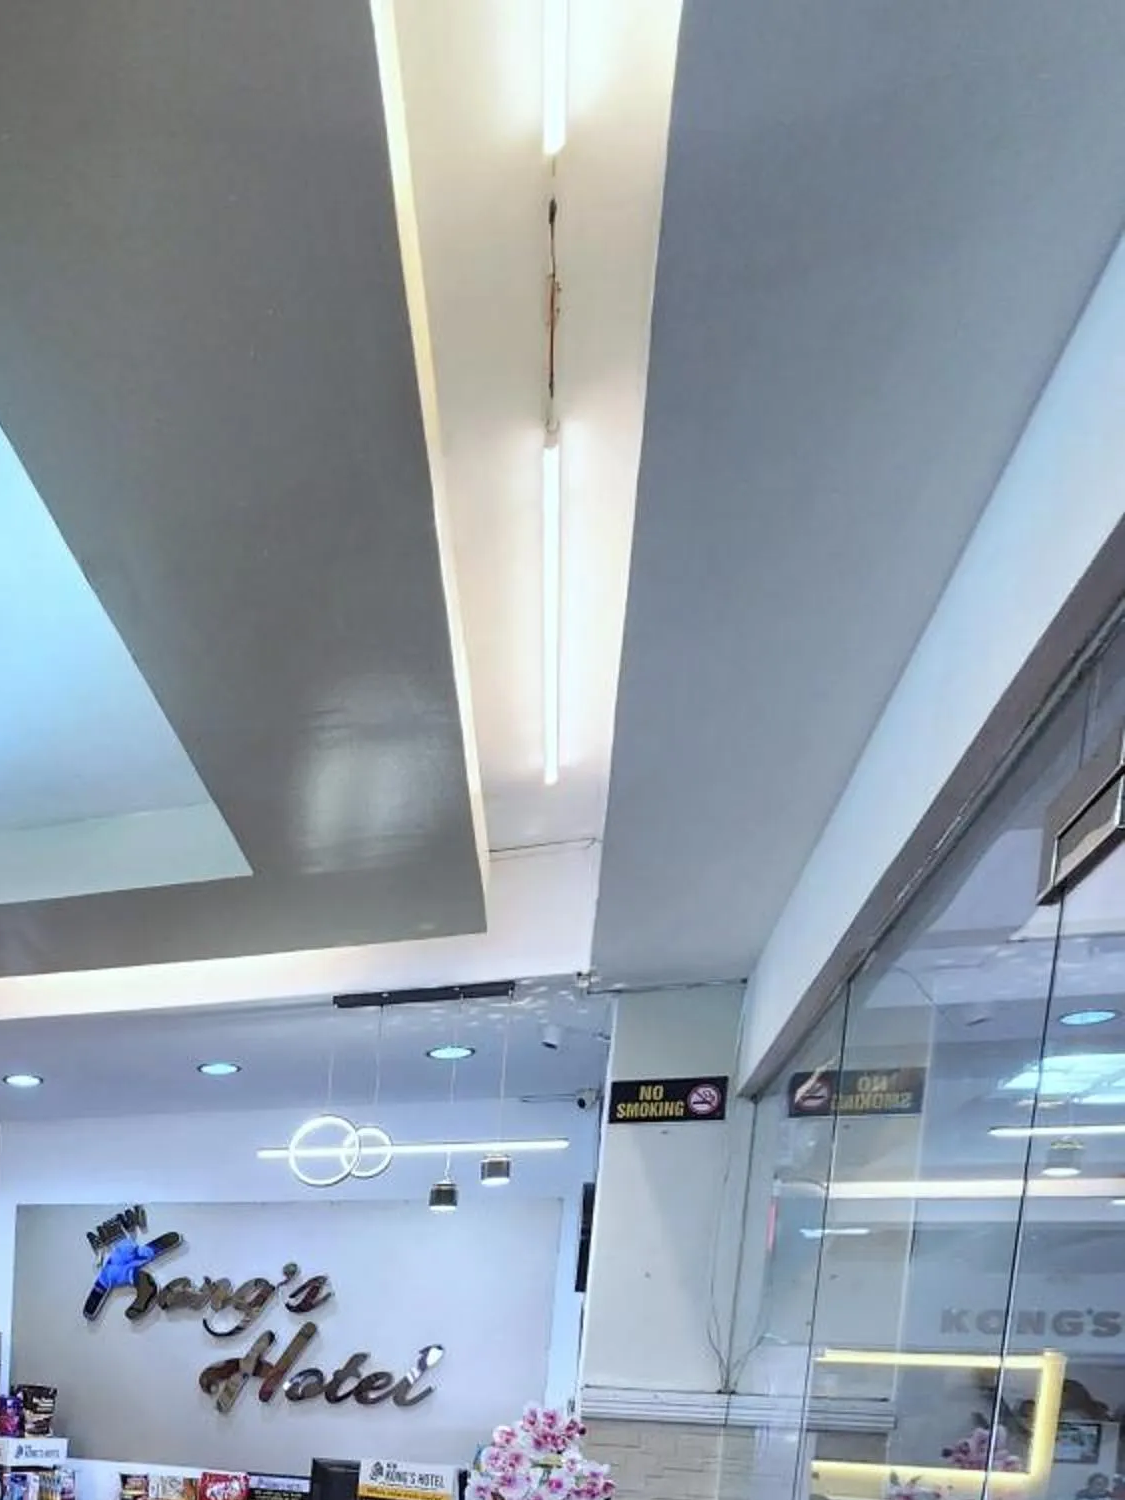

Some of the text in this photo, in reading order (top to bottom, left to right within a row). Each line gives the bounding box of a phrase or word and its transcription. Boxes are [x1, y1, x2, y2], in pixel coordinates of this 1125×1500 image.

[639, 1085, 664, 1100] NO
[617, 1101, 686, 1118] SMOKING
[940, 1307, 1122, 1337] KONG'S
[198, 1320, 445, 1414] Hotel
